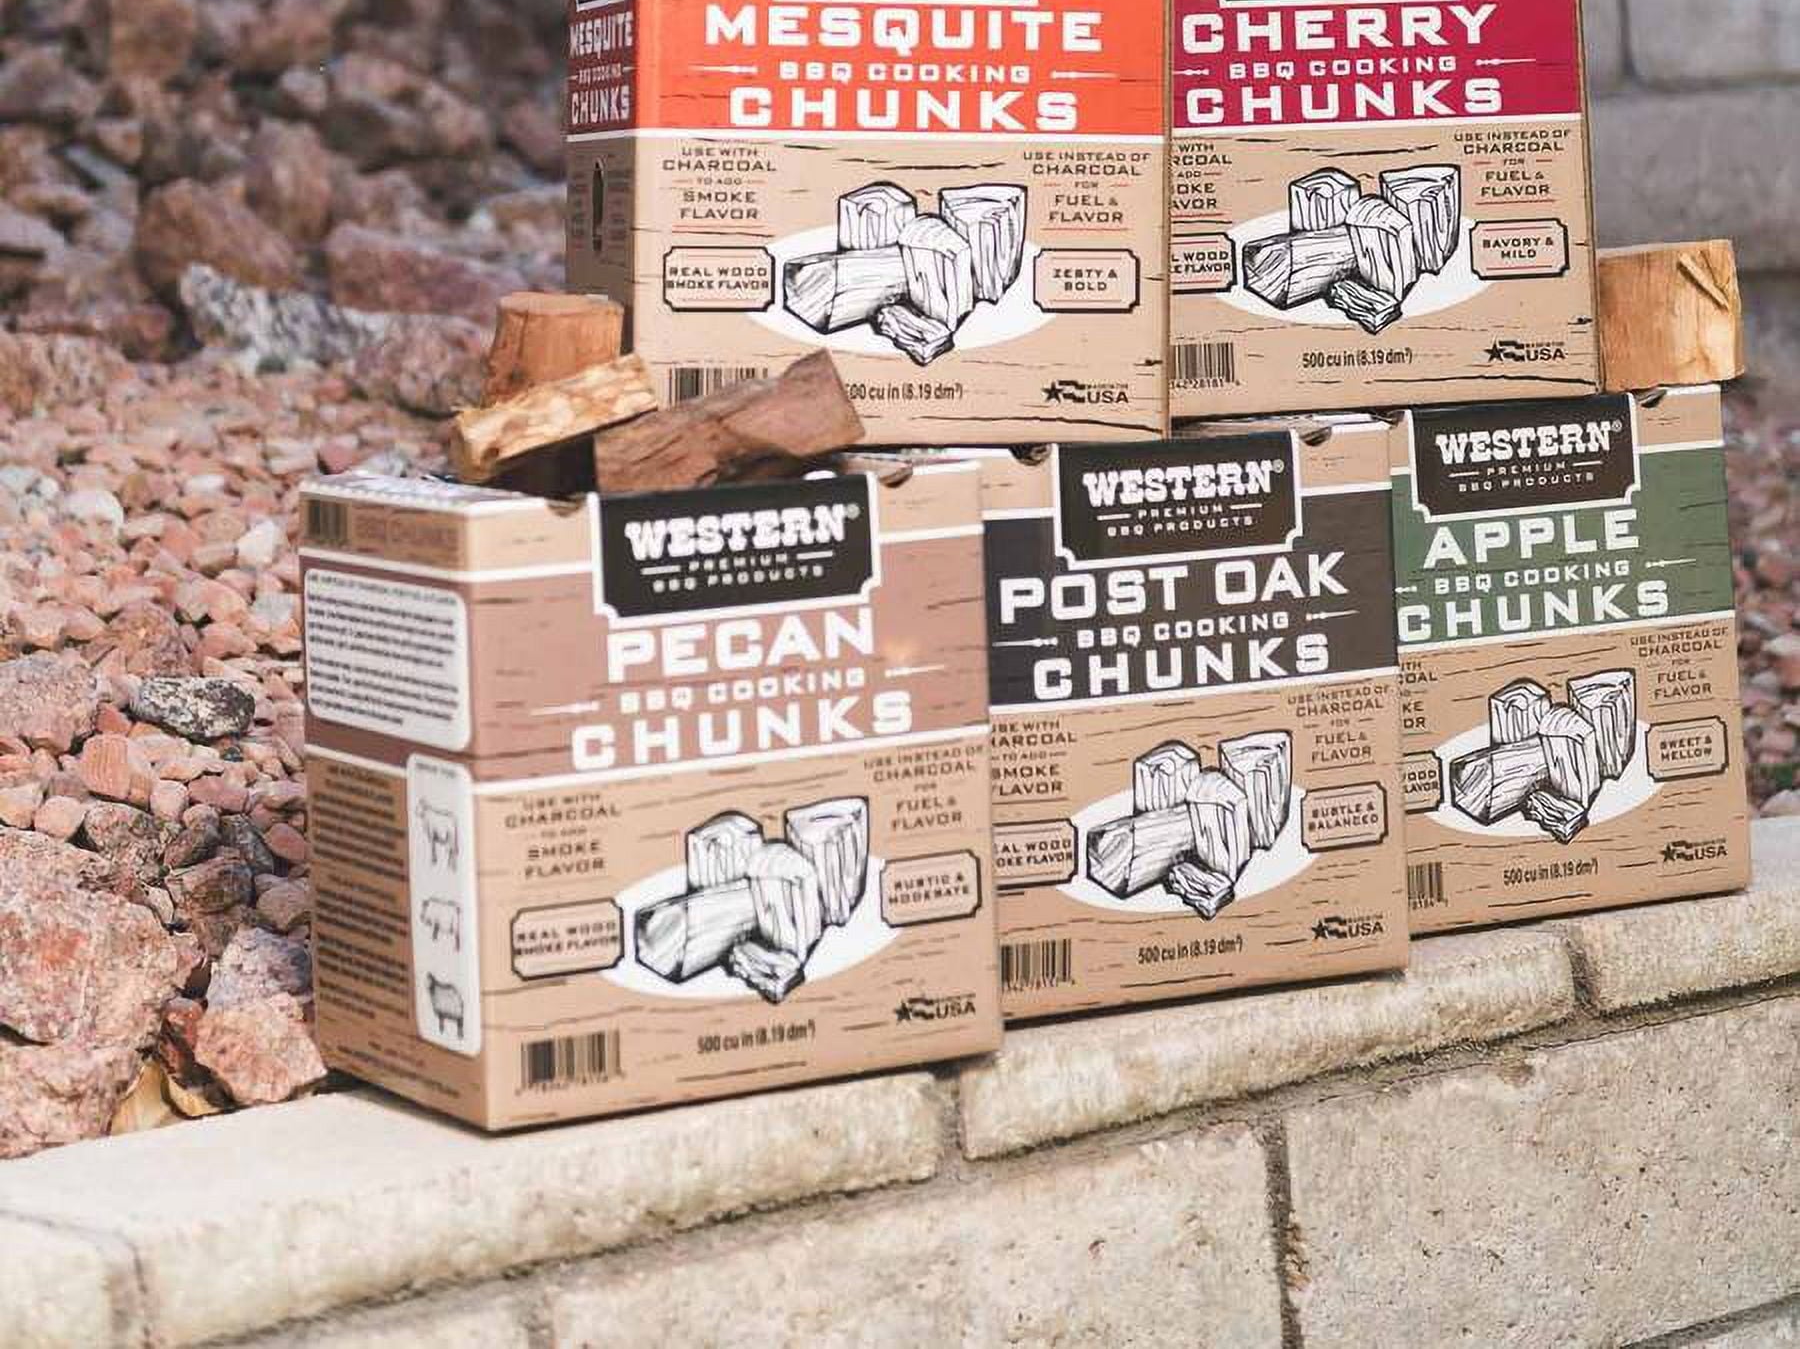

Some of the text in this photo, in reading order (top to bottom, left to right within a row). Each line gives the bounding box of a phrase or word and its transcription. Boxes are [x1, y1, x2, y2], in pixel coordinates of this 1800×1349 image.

[704, 3, 1102, 56] MESQUITE
[1182, 3, 1498, 54] CHERRY
[779, 61, 1031, 84] BBQ COOKING
[1229, 56, 1457, 80] BBQ COOKING
[572, 85, 630, 125] CHUNKS
[729, 86, 1078, 131] CHUNKS
[1186, 78, 1502, 123] CHUNKS
[1487, 129, 1549, 141] INSTEAD
[1552, 129, 1571, 138] OF
[1178, 143, 1214, 152] WITH
[1463, 141, 1565, 154] CHARCOAL
[663, 159, 777, 171] CHARCOAL
[1023, 152, 1151, 162] USE INSTEAD OF
[1033, 163, 1143, 176] CHARCOAL
[1485, 170, 1531, 182] FUEL
[683, 191, 757, 203] SMOKE
[1481, 185, 1550, 197] FLAVOR
[1055, 194, 1104, 206] FUEL
[680, 208, 758, 219] FLAVOR
[1049, 211, 1123, 223] FLAVOR
[1184, 251, 1229, 262] WOOD
[1501, 249, 1537, 259] MILD
[670, 267, 768, 276] REAL WOOD
[1184, 262, 1231, 273] FLAVOR
[718, 280, 769, 289] FLAVOR
[1064, 282, 1108, 291] BOLD
[1302, 351, 1326, 369] 500
[1326, 353, 1342, 367] cu
[1343, 350, 1356, 366] in
[1356, 348, 1385, 367] (8.19
[1527, 347, 1564, 361] USA
[868, 386, 885, 399] cu
[887, 383, 900, 399] in
[1087, 391, 1129, 403] USA
[1487, 462, 1566, 476] PREMIUM
[1459, 473, 1594, 492] BBQ PRODUCTS
[1138, 503, 1223, 519] PREMIUM
[1107, 516, 1253, 537] BBQ PRODUCTS
[1423, 508, 1639, 569] APPLE
[688, 554, 789, 571] PREMIUM
[707, 564, 823, 587] PRODUCTS
[1434, 560, 1630, 595] BBQ COOKING
[1000, 551, 1349, 624] POST OAK
[1397, 579, 1669, 642] CHUNKS
[1077, 611, 1289, 648] BBQ COOKING
[1658, 628, 1710, 642] INSTEAD
[607, 607, 875, 684] PECAN
[1638, 639, 1722, 657] CHARCOAL
[1033, 633, 1329, 700] CHUNKS
[1657, 670, 1696, 684] FUEL
[620, 667, 865, 714] BBQ COOKING
[1317, 686, 1371, 700] INSTEAD
[1654, 682, 1712, 700] FLAVOR
[1296, 699, 1384, 717] CHARCOAL
[572, 690, 913, 772] CHUNKS
[1023, 720, 1060, 731] WITH
[1315, 732, 1355, 744] FUEL
[1660, 736, 1700, 750] SWEET
[1311, 746, 1371, 763] FLAVOR
[1660, 748, 1712, 762] MELLOW
[873, 760, 976, 782] CHARCOAL
[891, 811, 962, 831] FLAVOR
[1025, 839, 1071, 851] WOOD
[1695, 845, 1728, 860] USA
[1026, 851, 1073, 865] FLAVOR
[524, 857, 604, 880] FLAVOR
[1503, 868, 1523, 886] 500
[1524, 869, 1538, 883] cu
[1538, 864, 1549, 881] in
[1347, 921, 1384, 939] USA
[1137, 945, 1160, 964] 500
[1161, 945, 1176, 961] cu
[1177, 943, 1189, 959] in
[935, 1001, 977, 1020] USA
[697, 1034, 721, 1054] 500
[740, 1031, 754, 1049] in
